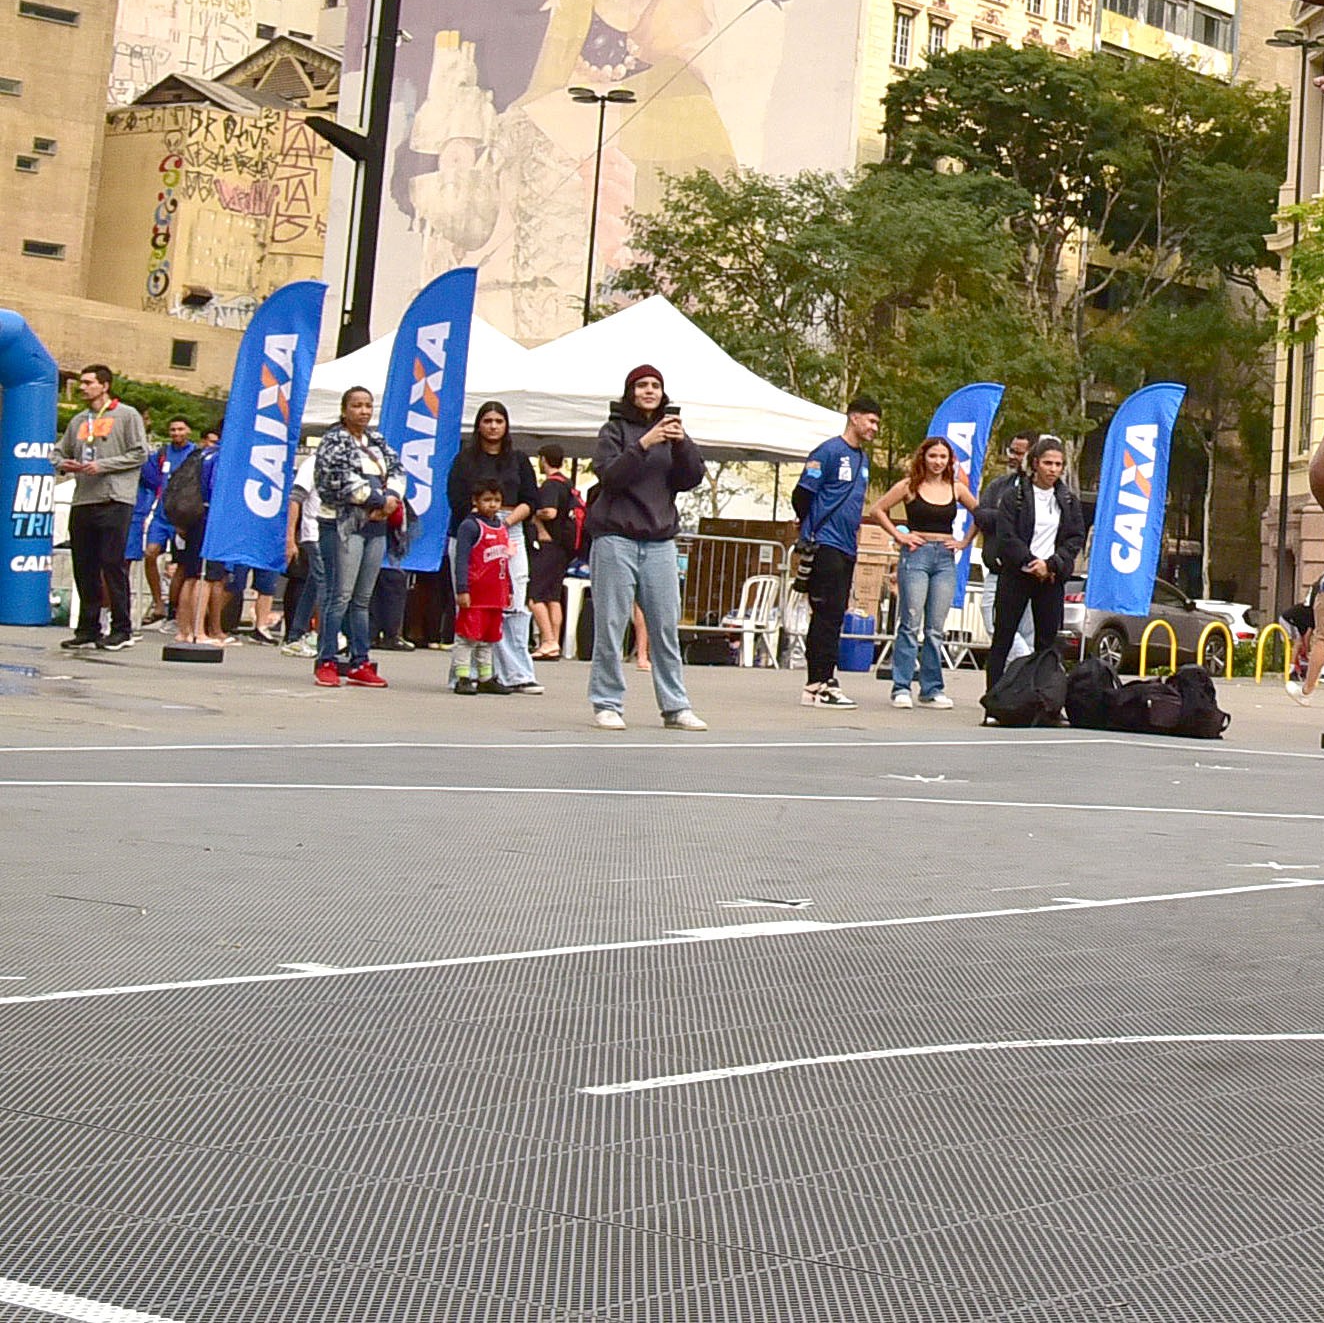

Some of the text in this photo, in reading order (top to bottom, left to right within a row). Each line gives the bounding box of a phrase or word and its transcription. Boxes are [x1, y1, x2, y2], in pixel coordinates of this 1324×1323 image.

[244, 333, 299, 518] CAIXA
[12, 513, 54, 537] TRI
[13, 475, 55, 512] NB
[1111, 424, 1158, 574] CAIXA
